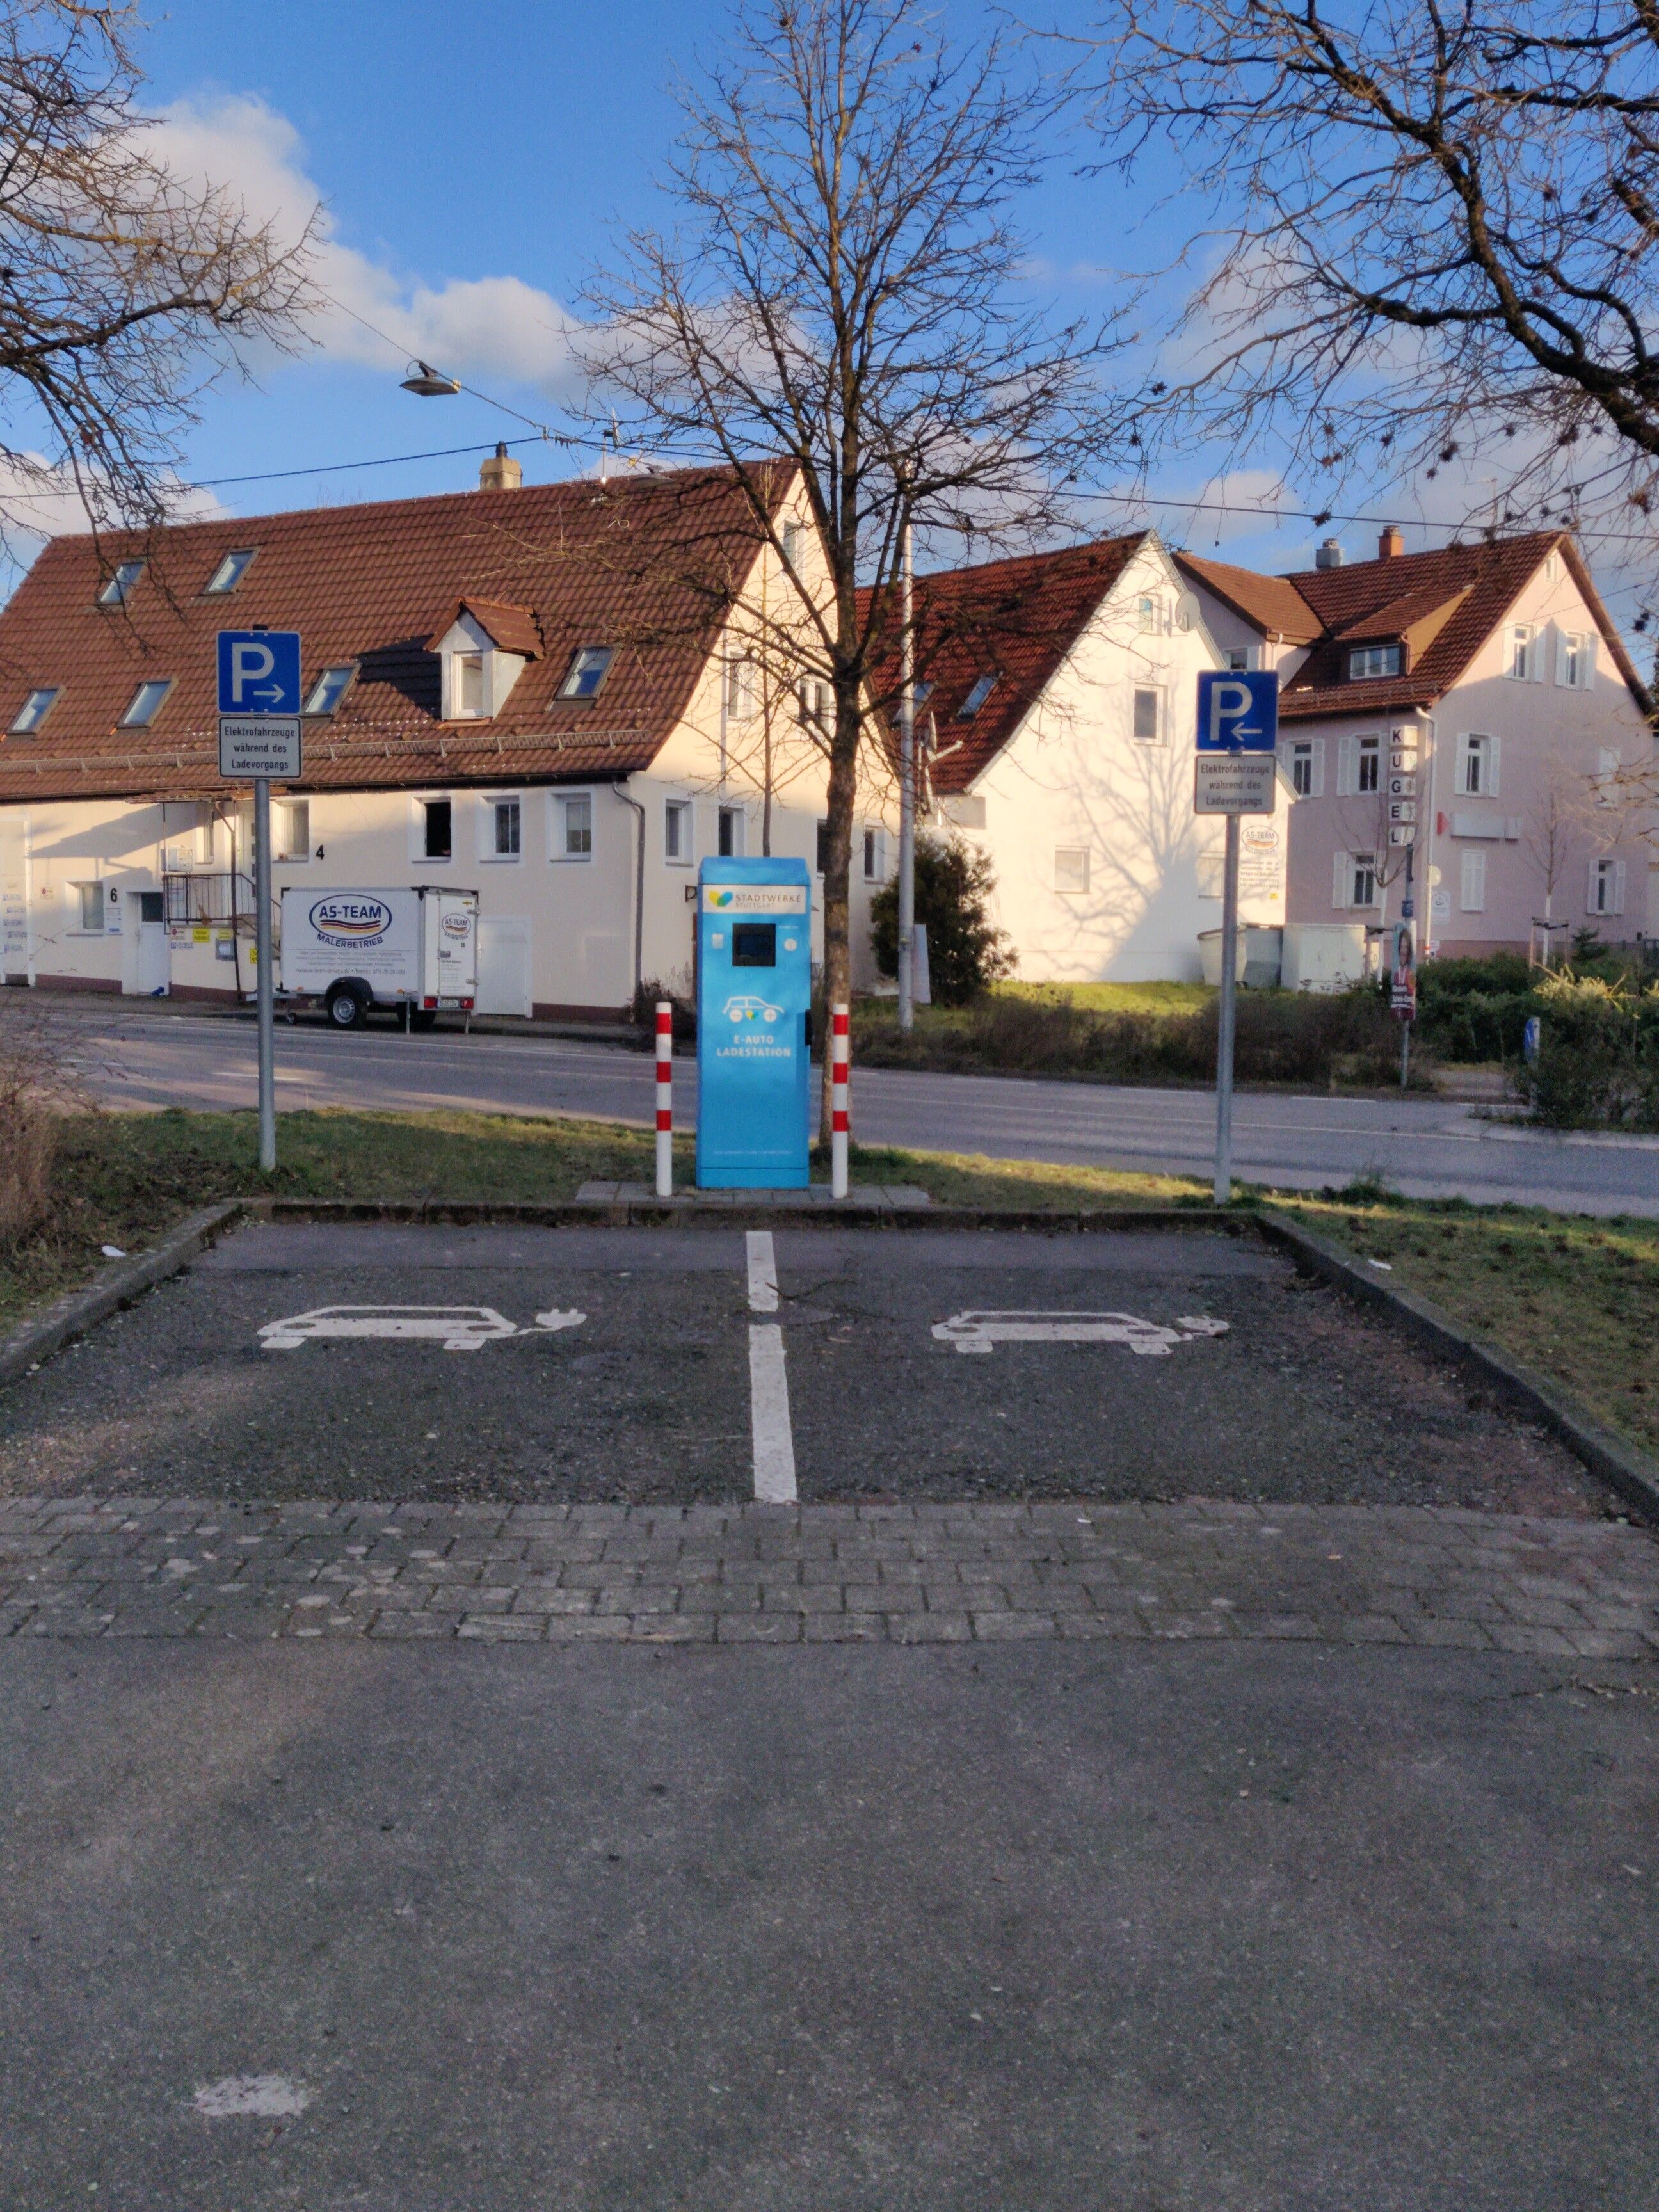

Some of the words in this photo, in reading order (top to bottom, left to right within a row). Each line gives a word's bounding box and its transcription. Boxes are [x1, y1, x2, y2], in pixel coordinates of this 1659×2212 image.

[232, 642, 275, 703] P
[1210, 681, 1253, 741] P
[225, 726, 295, 739] Elektrofahrzeuge
[234, 742, 269, 753] während
[273, 743, 287, 753] des
[232, 758, 289, 771] Ladevorgangs
[1201, 764, 1270, 776] Elektrofahrzeuge
[1247, 780, 1262, 789] des
[1391, 729, 1402, 843] KUGEL
[1206, 796, 1263, 808] Ladevorgangs
[1246, 831, 1275, 840] AS-TEAM
[316, 844, 325, 860] 4
[109, 888, 118, 902] 6
[735, 894, 801, 902] STADTWERKE
[319, 905, 381, 918] AS-TEAM
[445, 918, 468, 926] AS-TEAM
[316, 933, 383, 949] MALERBETRIEB
[717, 1048, 791, 1057] LADESTATION
